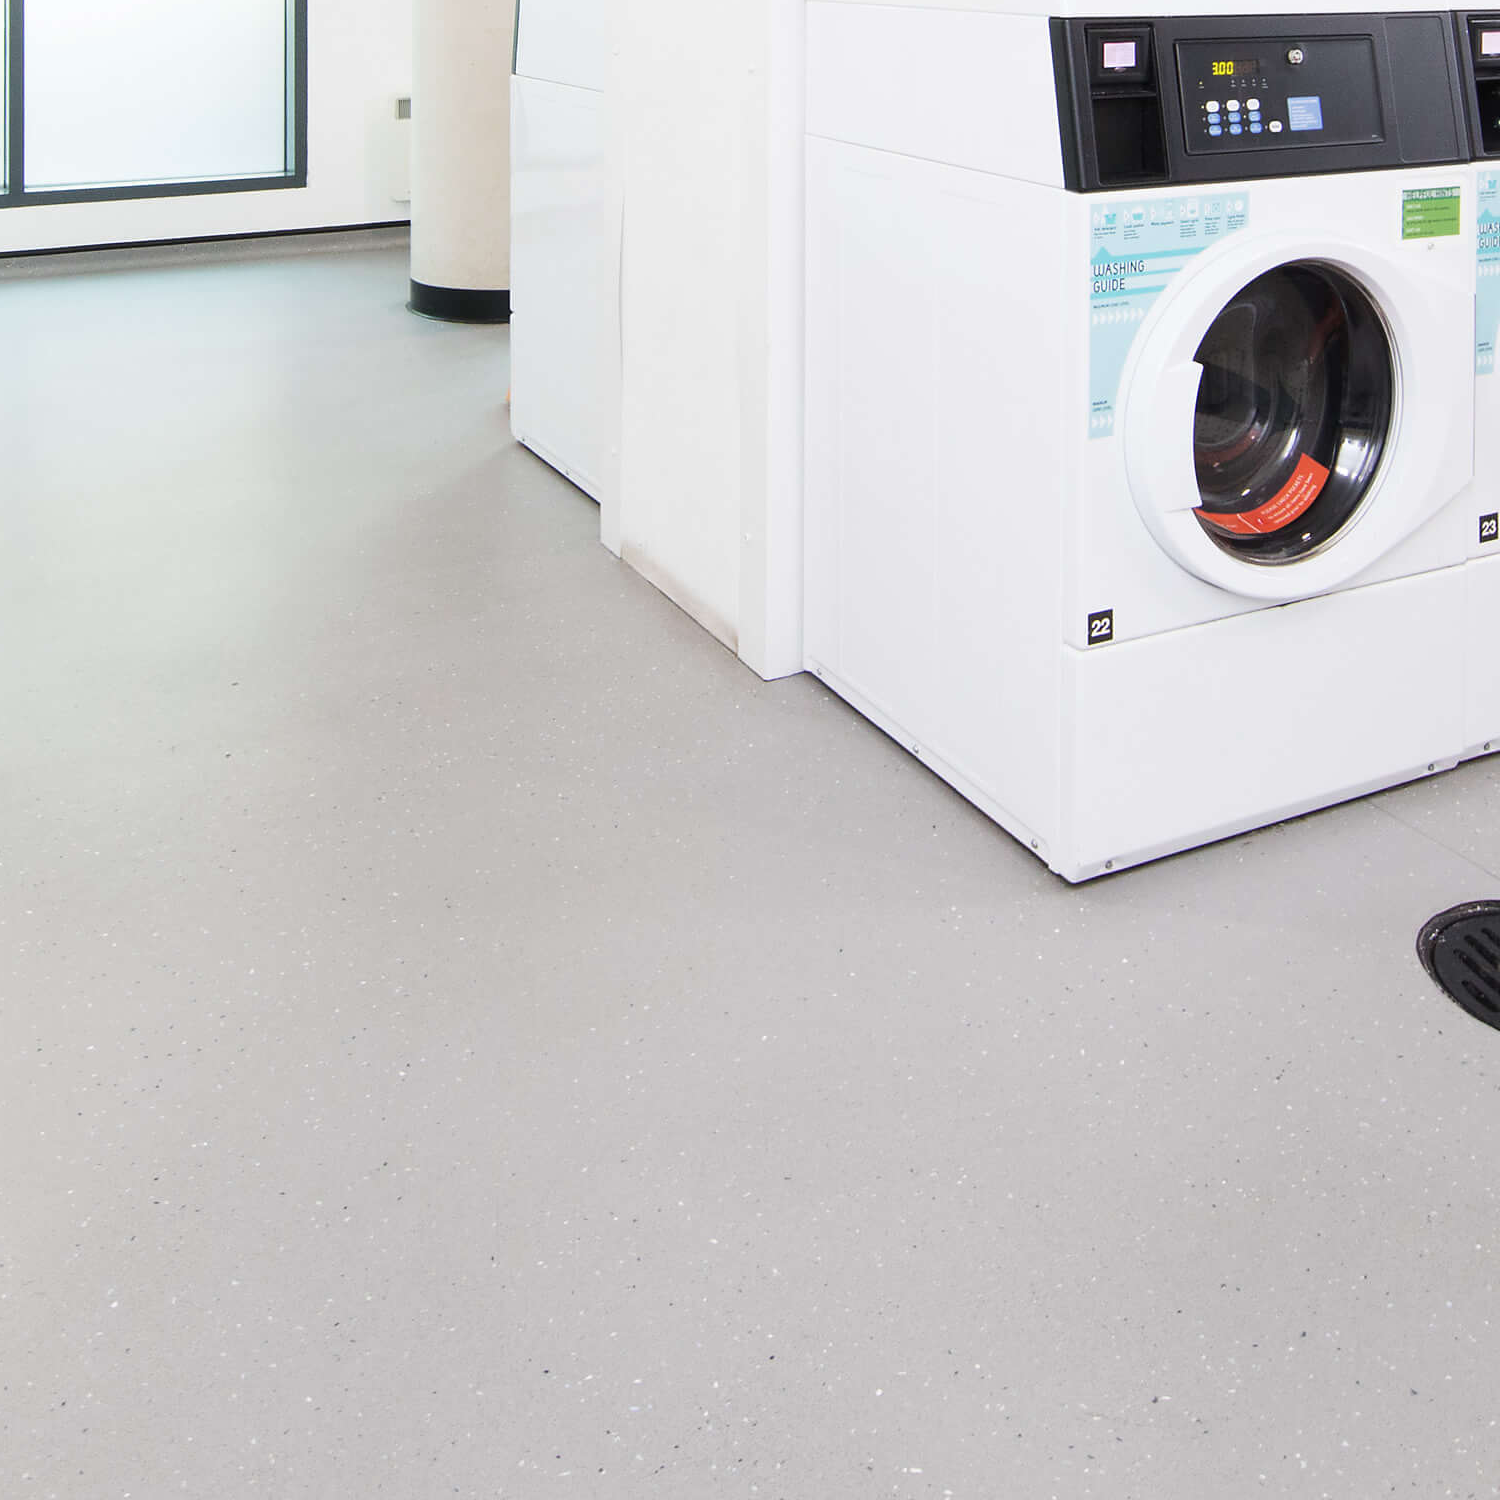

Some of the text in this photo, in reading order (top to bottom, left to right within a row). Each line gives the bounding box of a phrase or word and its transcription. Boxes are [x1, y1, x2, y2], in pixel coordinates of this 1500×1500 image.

[1093, 260, 1145, 277] WASHING
[1093, 278, 1125, 293] GUIDE
[1482, 520, 1497, 536] 23
[1091, 617, 1111, 637] 22
